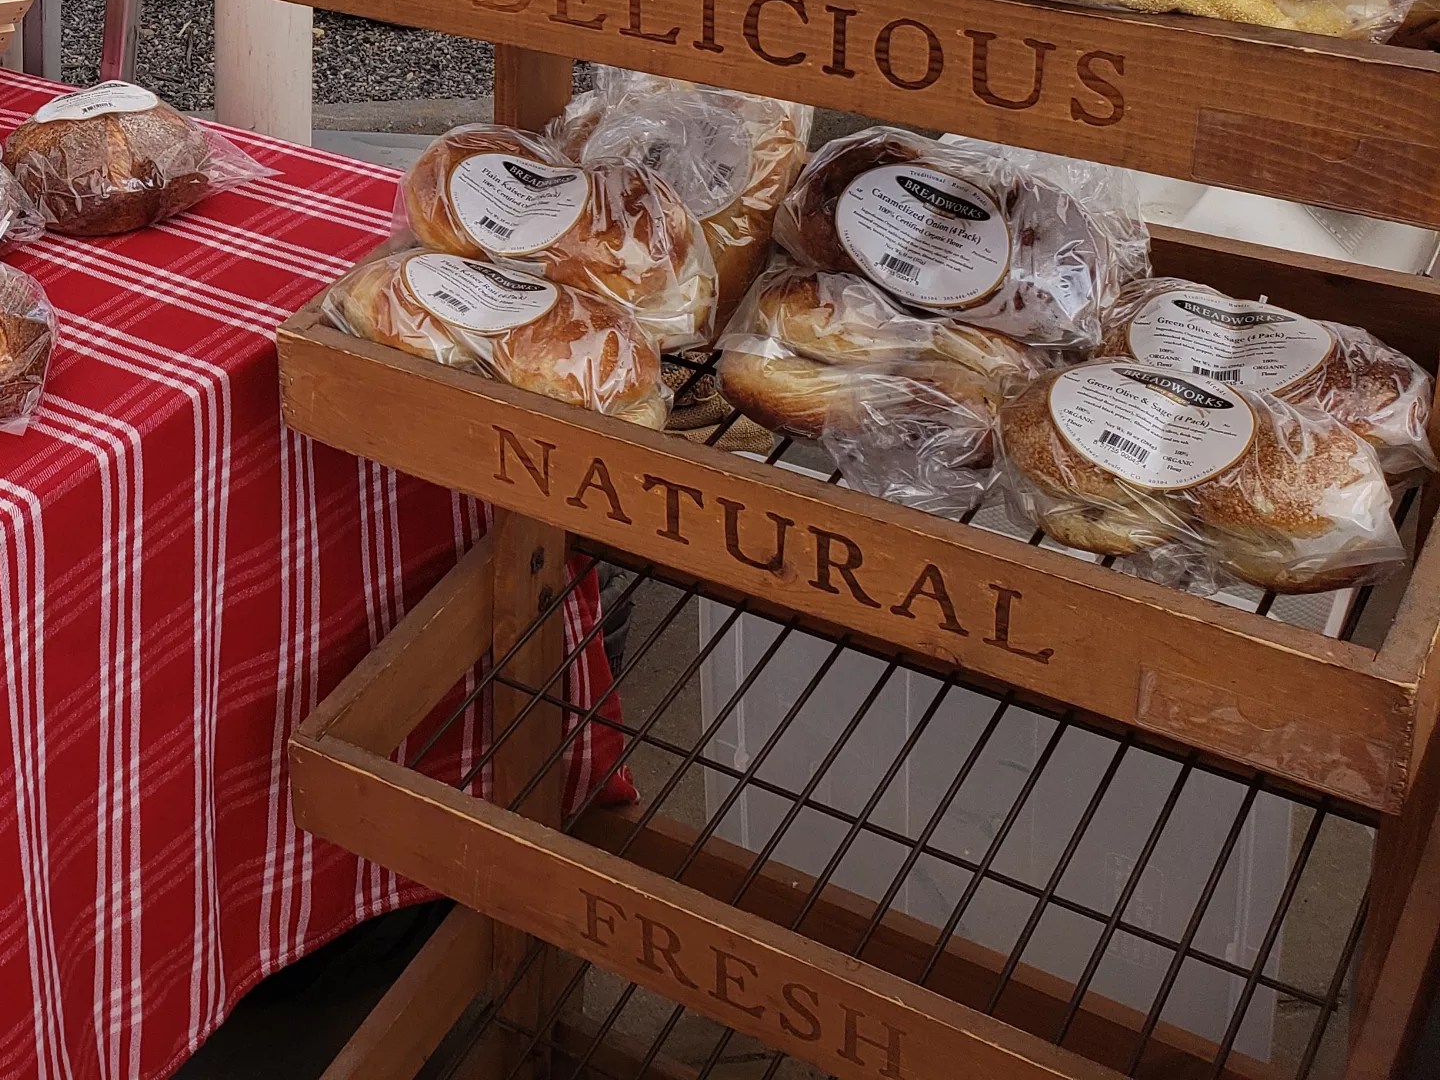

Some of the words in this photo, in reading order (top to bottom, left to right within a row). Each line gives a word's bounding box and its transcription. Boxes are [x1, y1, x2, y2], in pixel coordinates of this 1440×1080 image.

[482, 167, 501, 184] Plain
[501, 182, 525, 200] Kaiser
[904, 179, 984, 219] BREADWORKS
[872, 188, 925, 222] Caramelized
[925, 217, 950, 232] Onion
[957, 229, 982, 245] Pack)
[878, 205, 895, 218] 100%
[895, 214, 929, 234] Certified
[924, 229, 947, 242] Organic
[946, 238, 963, 249] Flour
[469, 264, 540, 291] BREADWORKS
[1184, 302, 1286, 324] BREADWORKS
[1157, 317, 1184, 328] Green
[1187, 324, 1211, 335] Olive
[1223, 335, 1245, 344] Sage
[1258, 332, 1285, 340] Pack)
[1087, 378, 1113, 392] Green
[1115, 387, 1139, 401] Olive
[1141, 397, 1149, 405] &
[1150, 402, 1173, 418] Sage
[1174, 413, 1186, 422] (4
[1186, 416, 1210, 428] Pack)
[1123, 369, 1224, 408] BREADWORKS
[1063, 408, 1096, 425] ORGANIC
[1066, 418, 1083, 428] Flour
[1100, 441, 1119, 454] 57755
[1162, 455, 1195, 466] ORGANIC
[492, 424, 1055, 665] NATURAL
[578, 887, 907, 1078] FRESH
